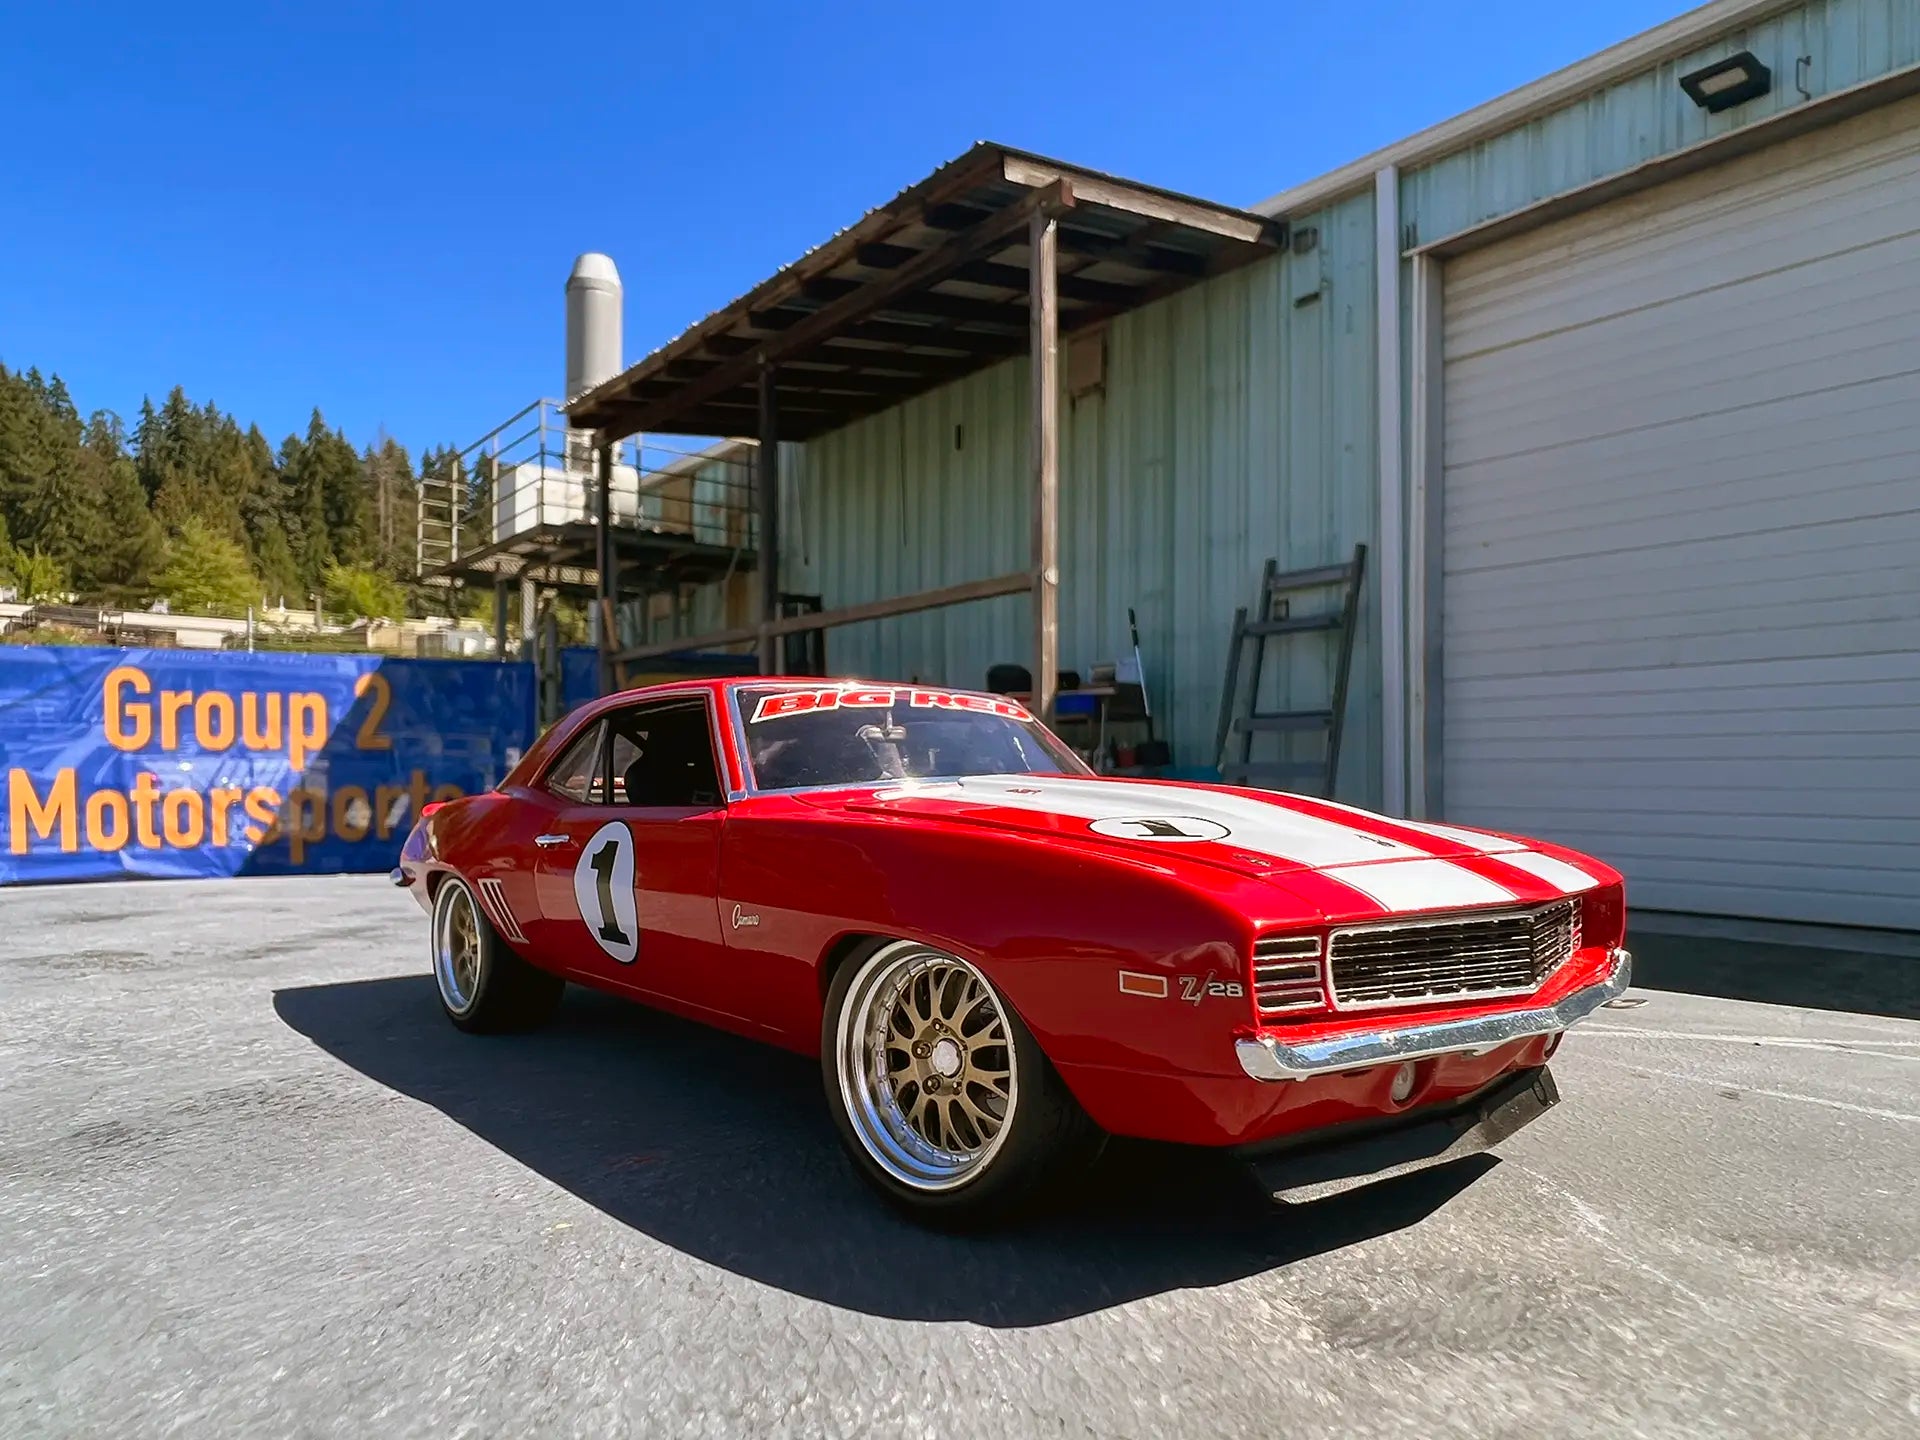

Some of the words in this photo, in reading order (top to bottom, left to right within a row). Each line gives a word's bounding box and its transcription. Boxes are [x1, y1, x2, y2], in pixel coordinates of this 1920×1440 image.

[103, 666, 328, 771] Group
[354, 673, 391, 750] 2
[750, 689, 895, 724] BIG
[910, 690, 1033, 722] RED
[8, 767, 464, 864] Motorsport
[1120, 819, 1204, 838] 1
[591, 840, 631, 946] 1
[732, 903, 760, 929] Camaro
[1179, 971, 1243, 1007] Z/28
